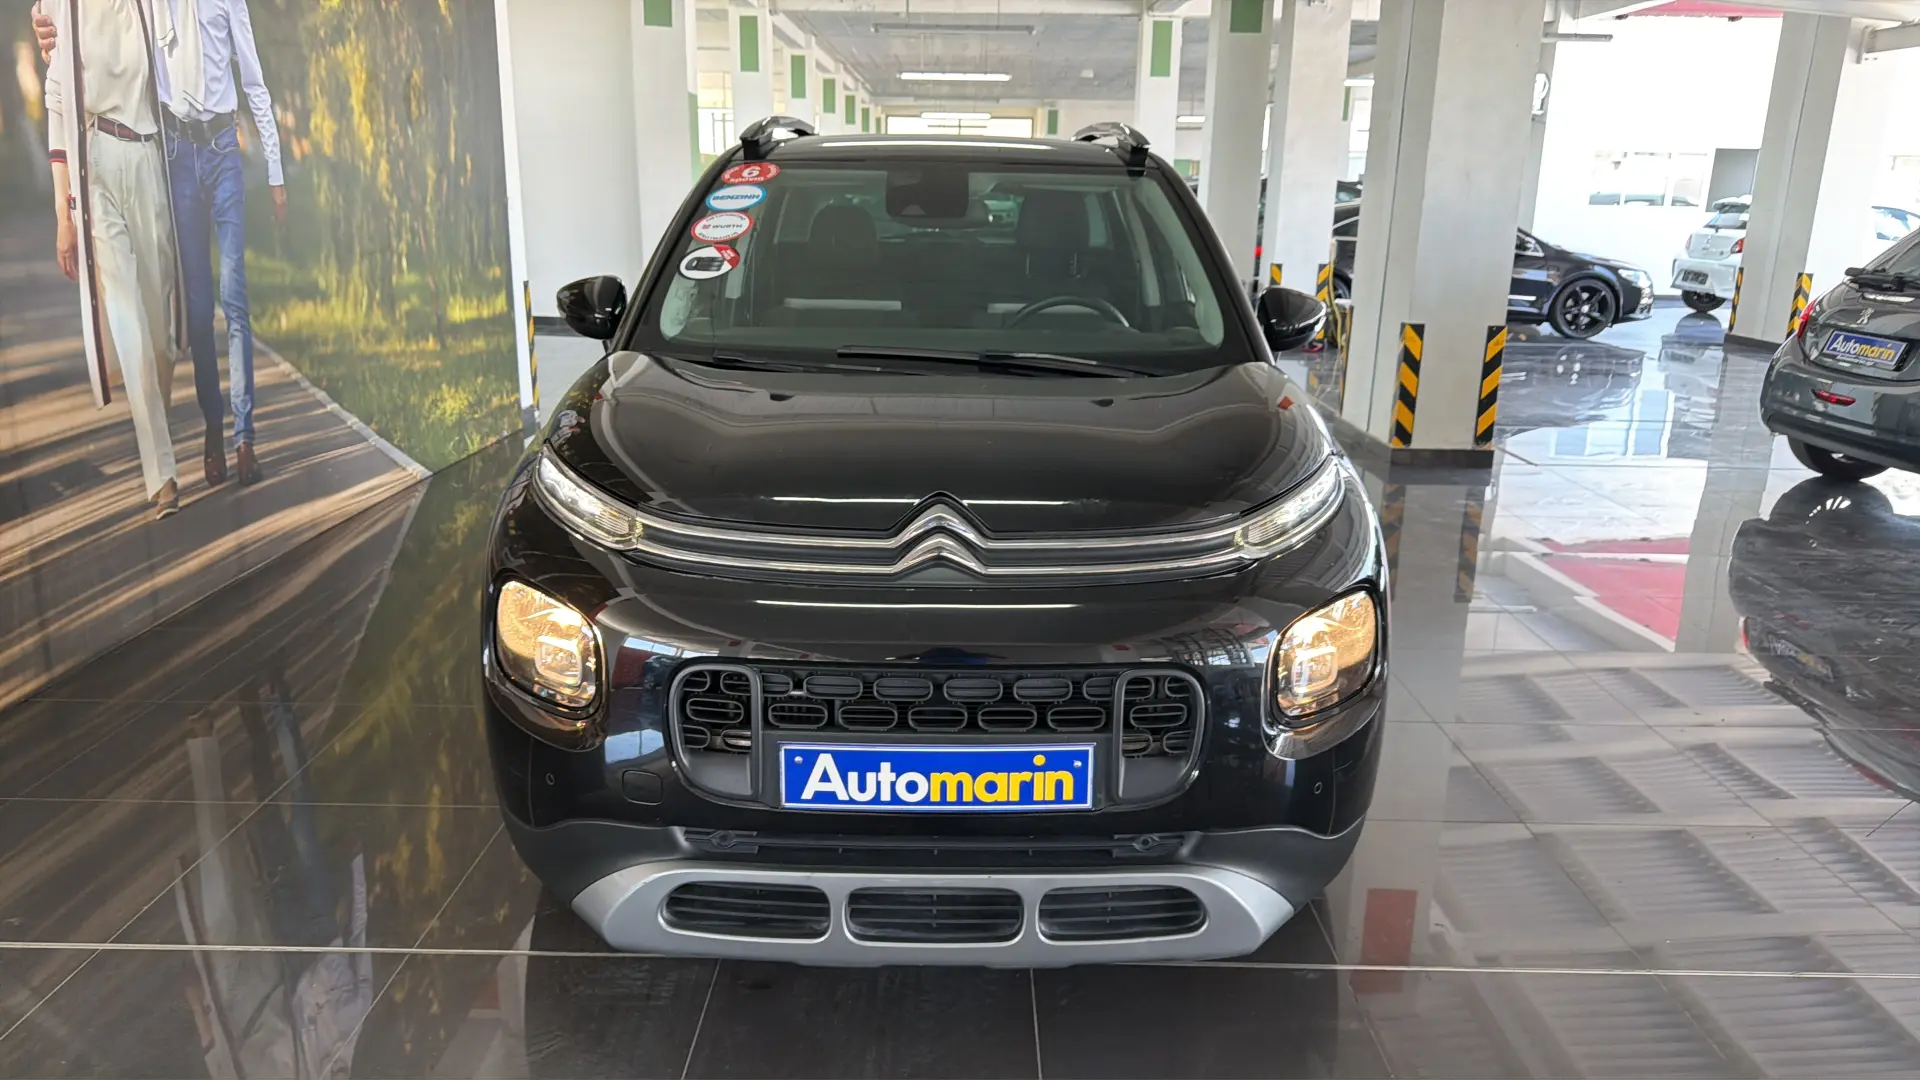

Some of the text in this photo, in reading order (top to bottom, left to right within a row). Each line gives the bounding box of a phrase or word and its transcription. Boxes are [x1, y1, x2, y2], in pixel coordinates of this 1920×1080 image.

[742, 166, 761, 177] 6
[1829, 334, 1896, 361] Automarin
[800, 752, 1074, 803] Automarin
